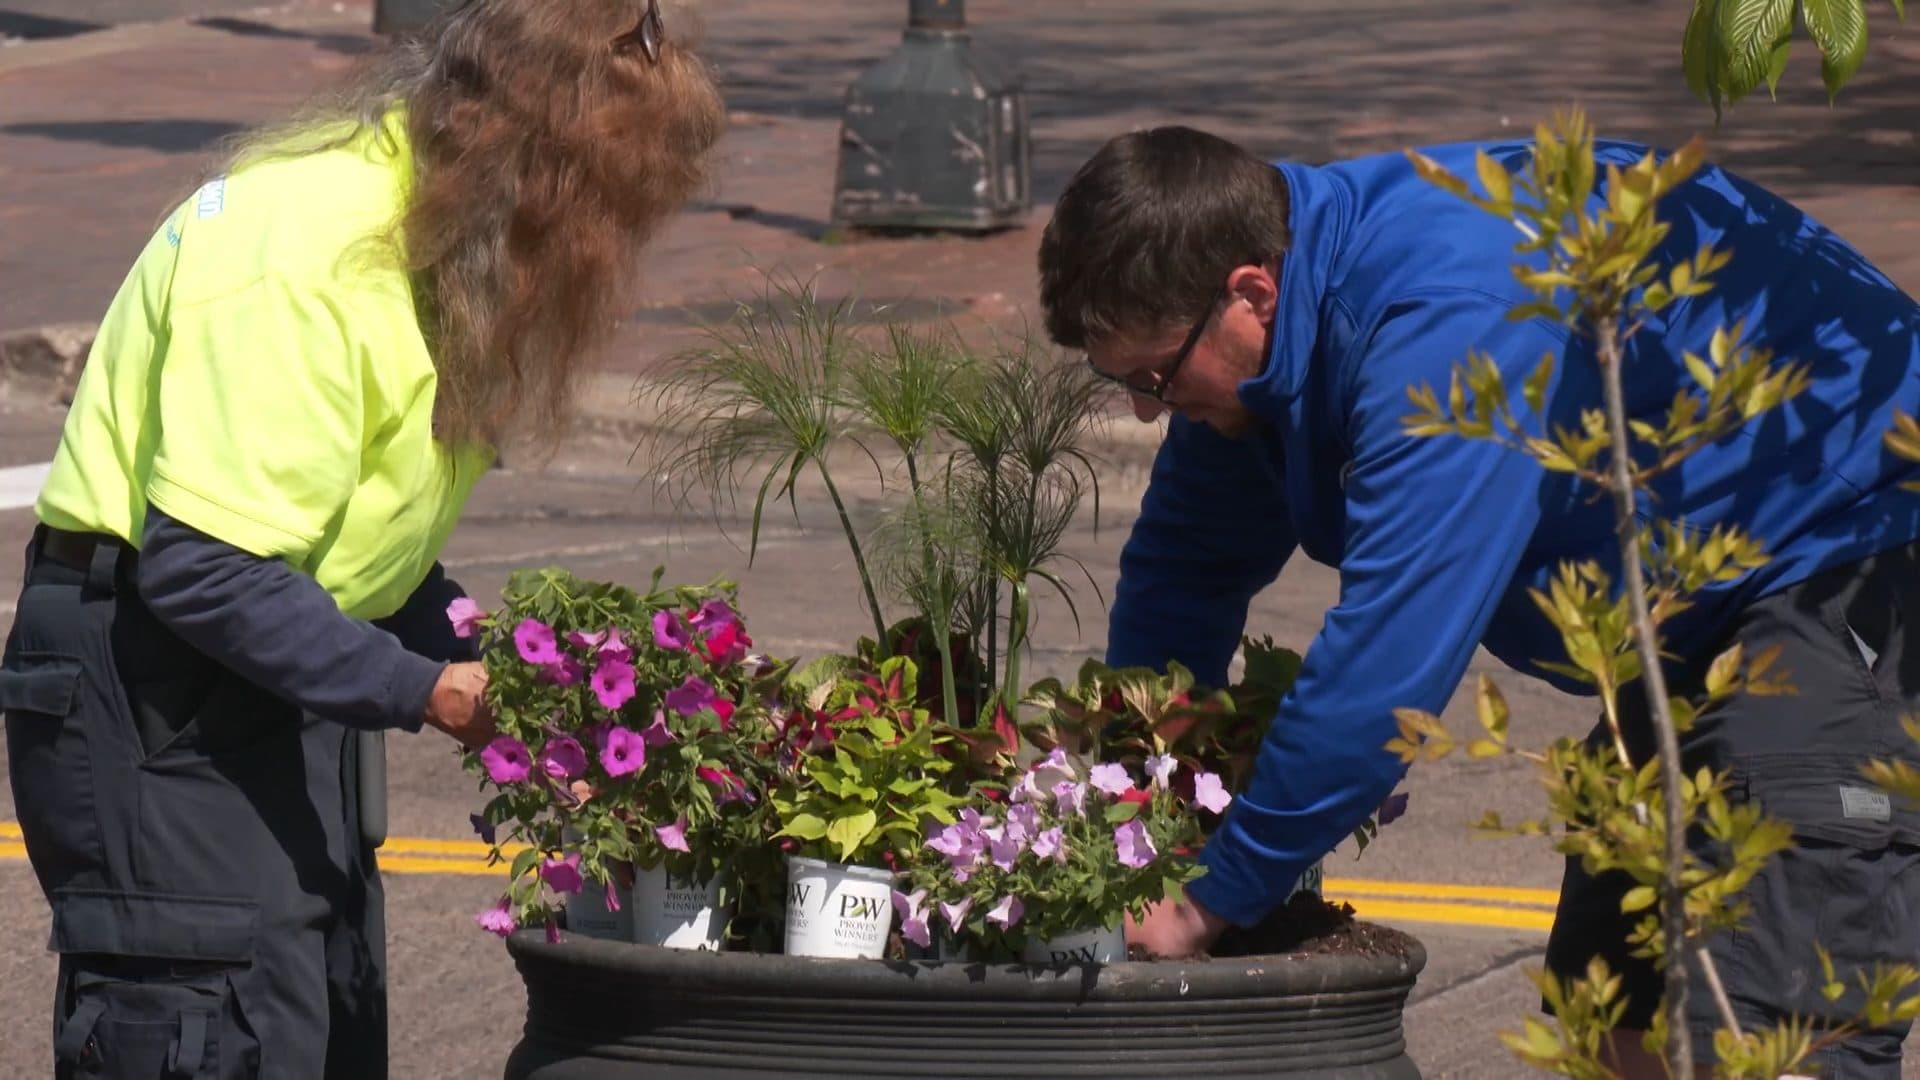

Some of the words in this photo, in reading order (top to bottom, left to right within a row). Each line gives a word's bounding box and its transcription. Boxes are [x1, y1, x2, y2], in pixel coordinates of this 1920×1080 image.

[666, 891, 707, 902] PROVEN
[840, 894, 886, 921] PW
[839, 919, 878, 932] PROVEN
